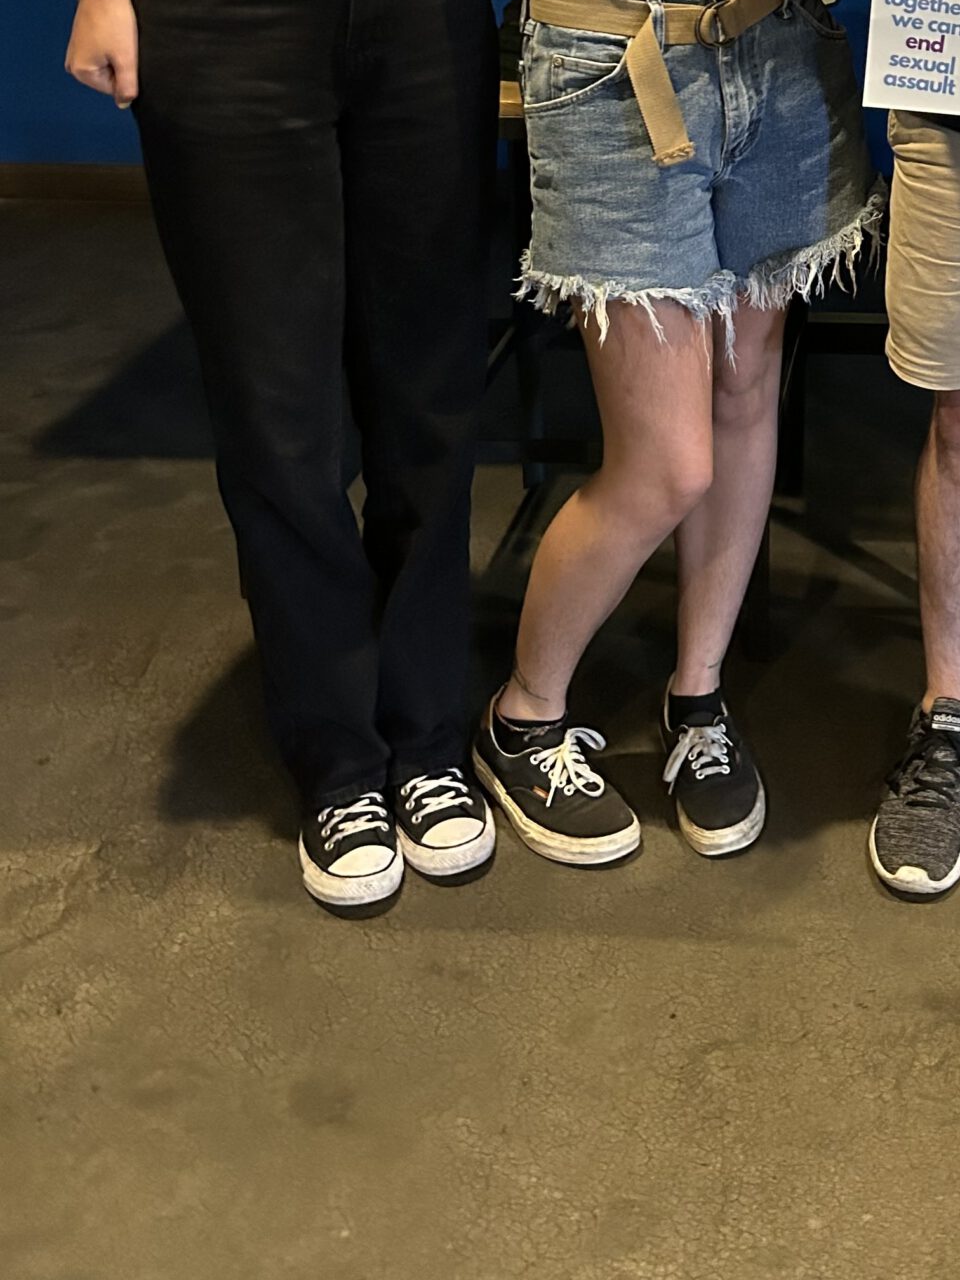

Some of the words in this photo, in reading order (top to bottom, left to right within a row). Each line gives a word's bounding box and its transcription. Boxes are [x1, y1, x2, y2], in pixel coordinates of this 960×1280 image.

[892, 14, 924, 30] we
[906, 35, 945, 53] end
[889, 54, 956, 75] sexual
[883, 73, 956, 96] assault
